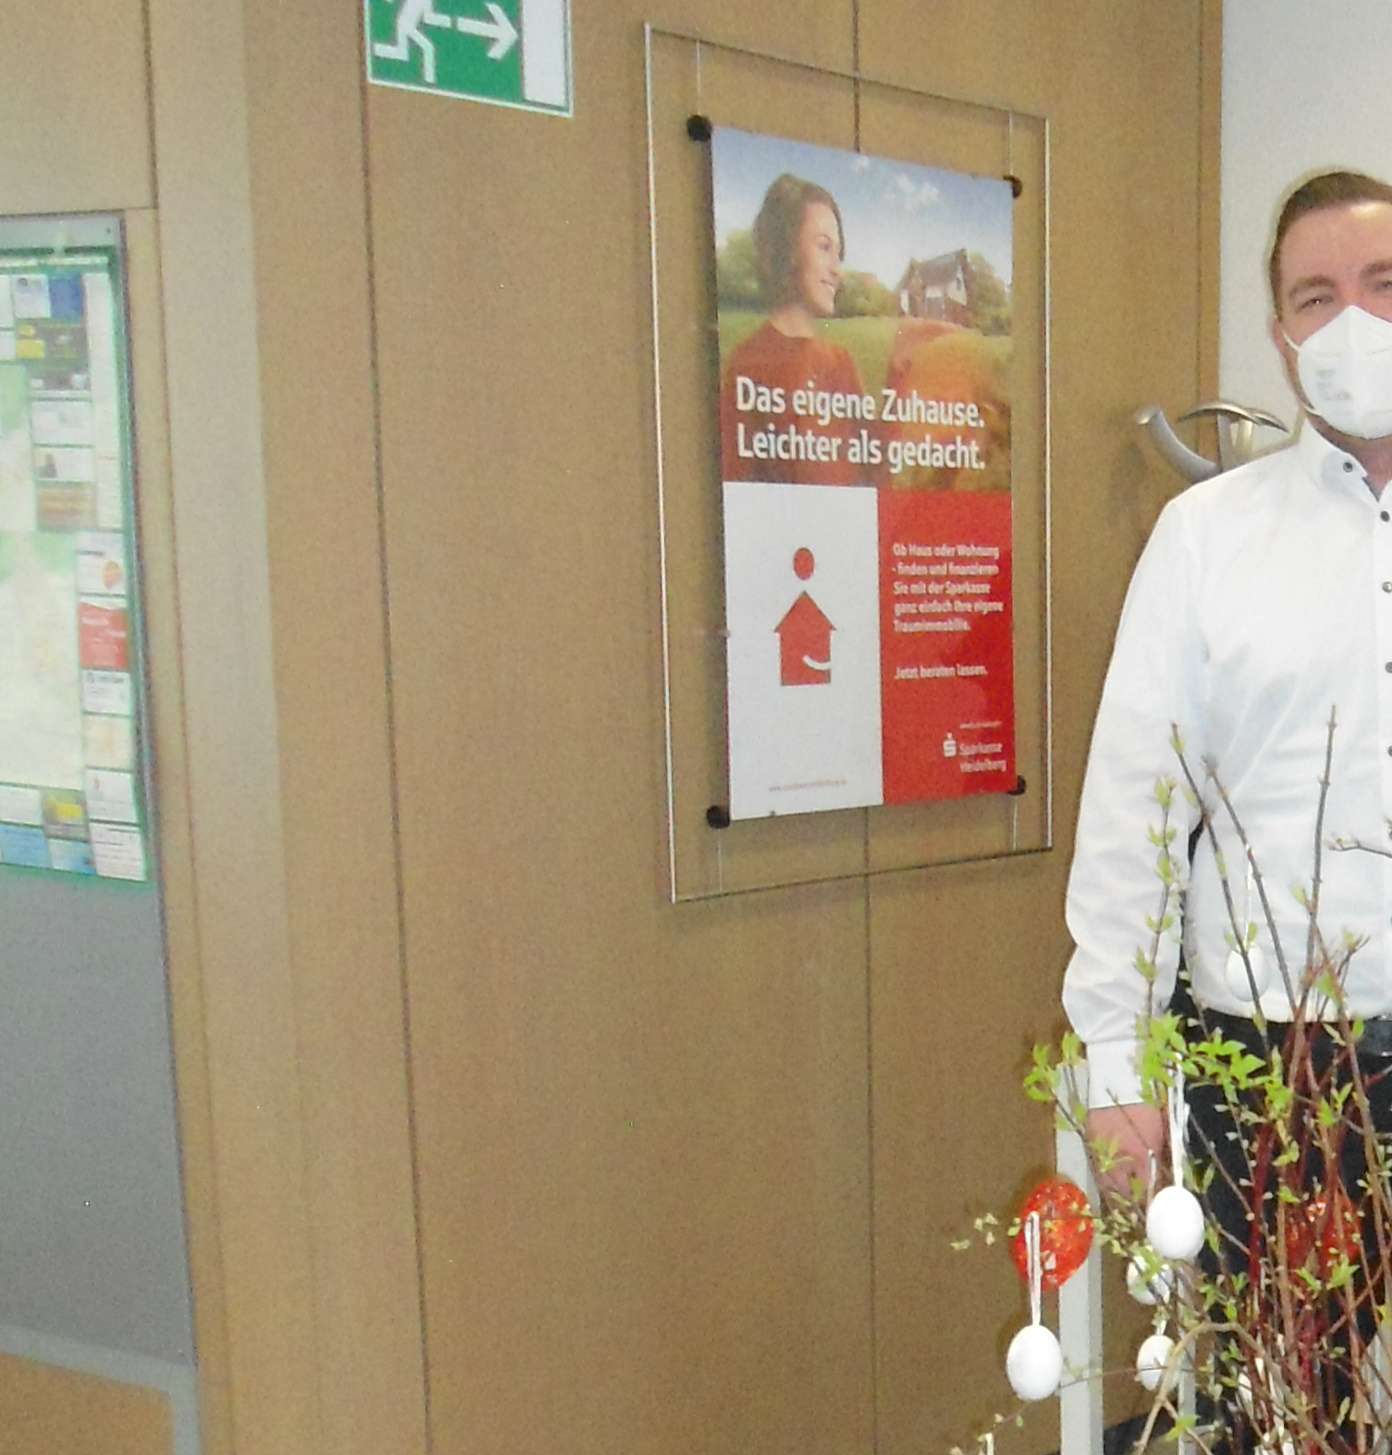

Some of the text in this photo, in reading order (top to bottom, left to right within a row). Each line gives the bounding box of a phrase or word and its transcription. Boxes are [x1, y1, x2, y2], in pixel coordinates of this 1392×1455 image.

[736, 375, 985, 428] Das eigene Zuhause.
[736, 422, 985, 474] Leichter als gedacht.
